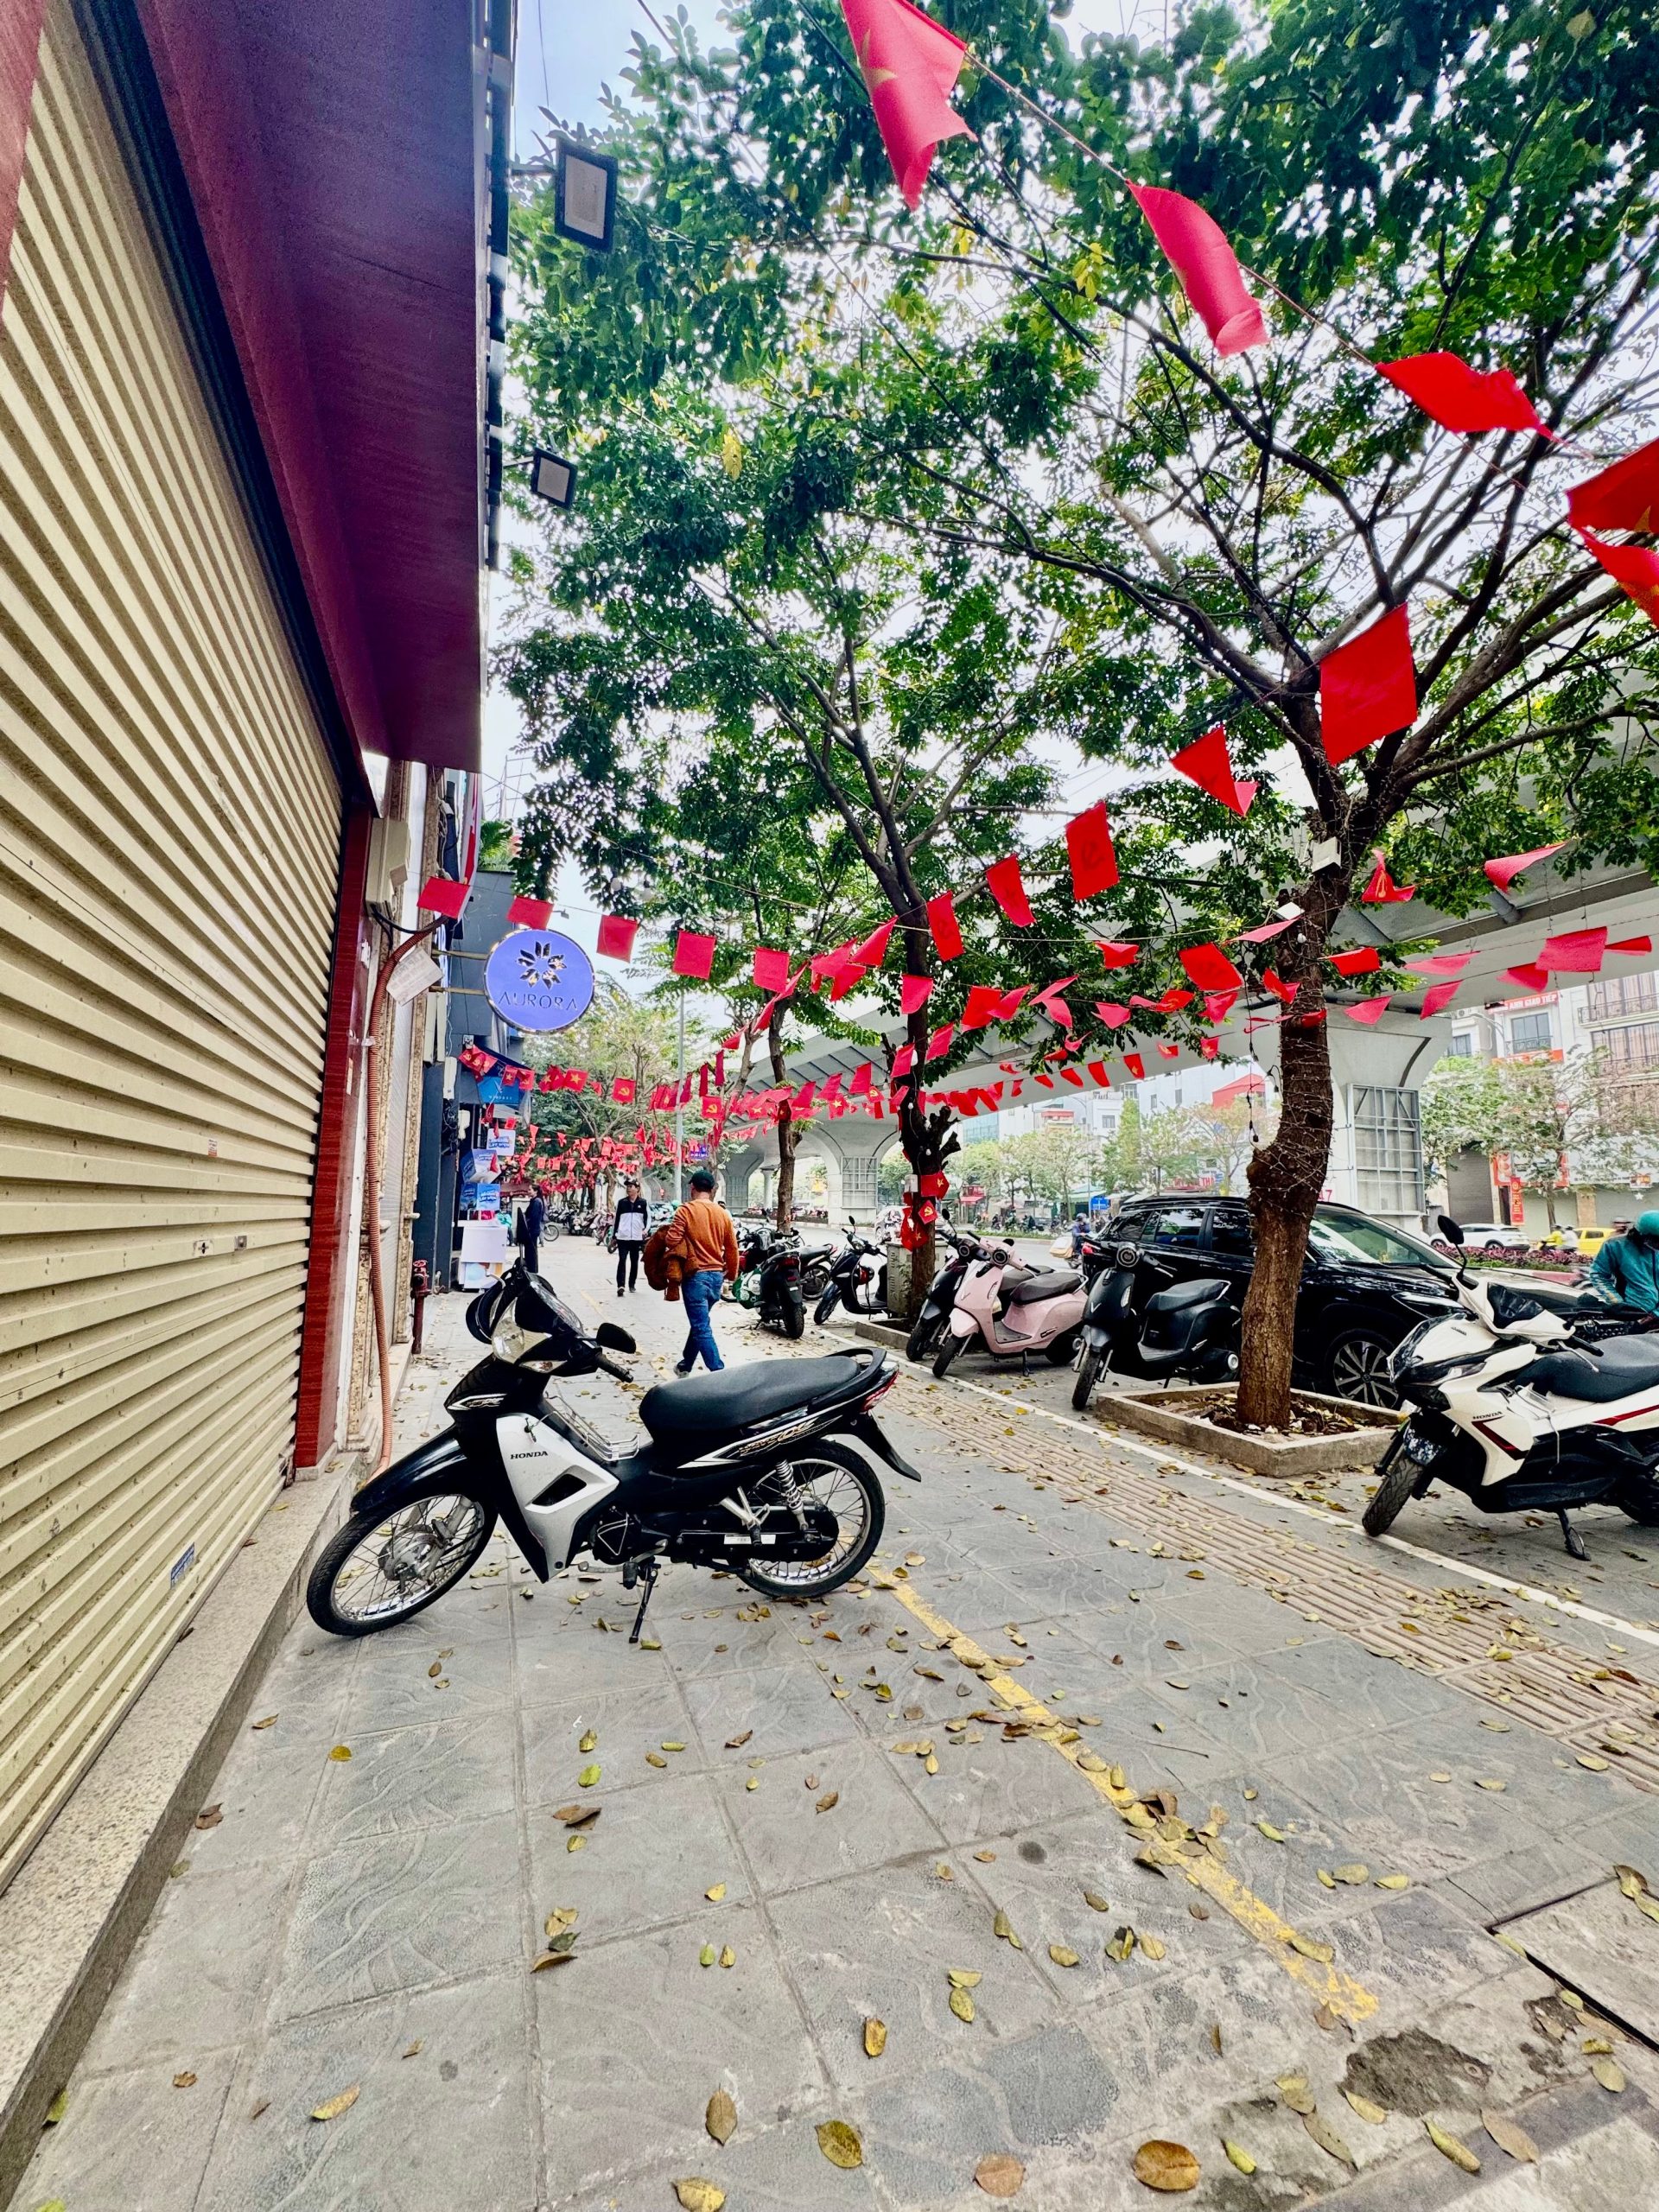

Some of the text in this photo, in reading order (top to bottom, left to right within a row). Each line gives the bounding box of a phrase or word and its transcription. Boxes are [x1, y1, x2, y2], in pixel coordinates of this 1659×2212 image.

[499, 991, 578, 1011] AURORA
[1472, 1410, 1503, 1420] HONDA
[510, 1451, 549, 1459] HONDA
